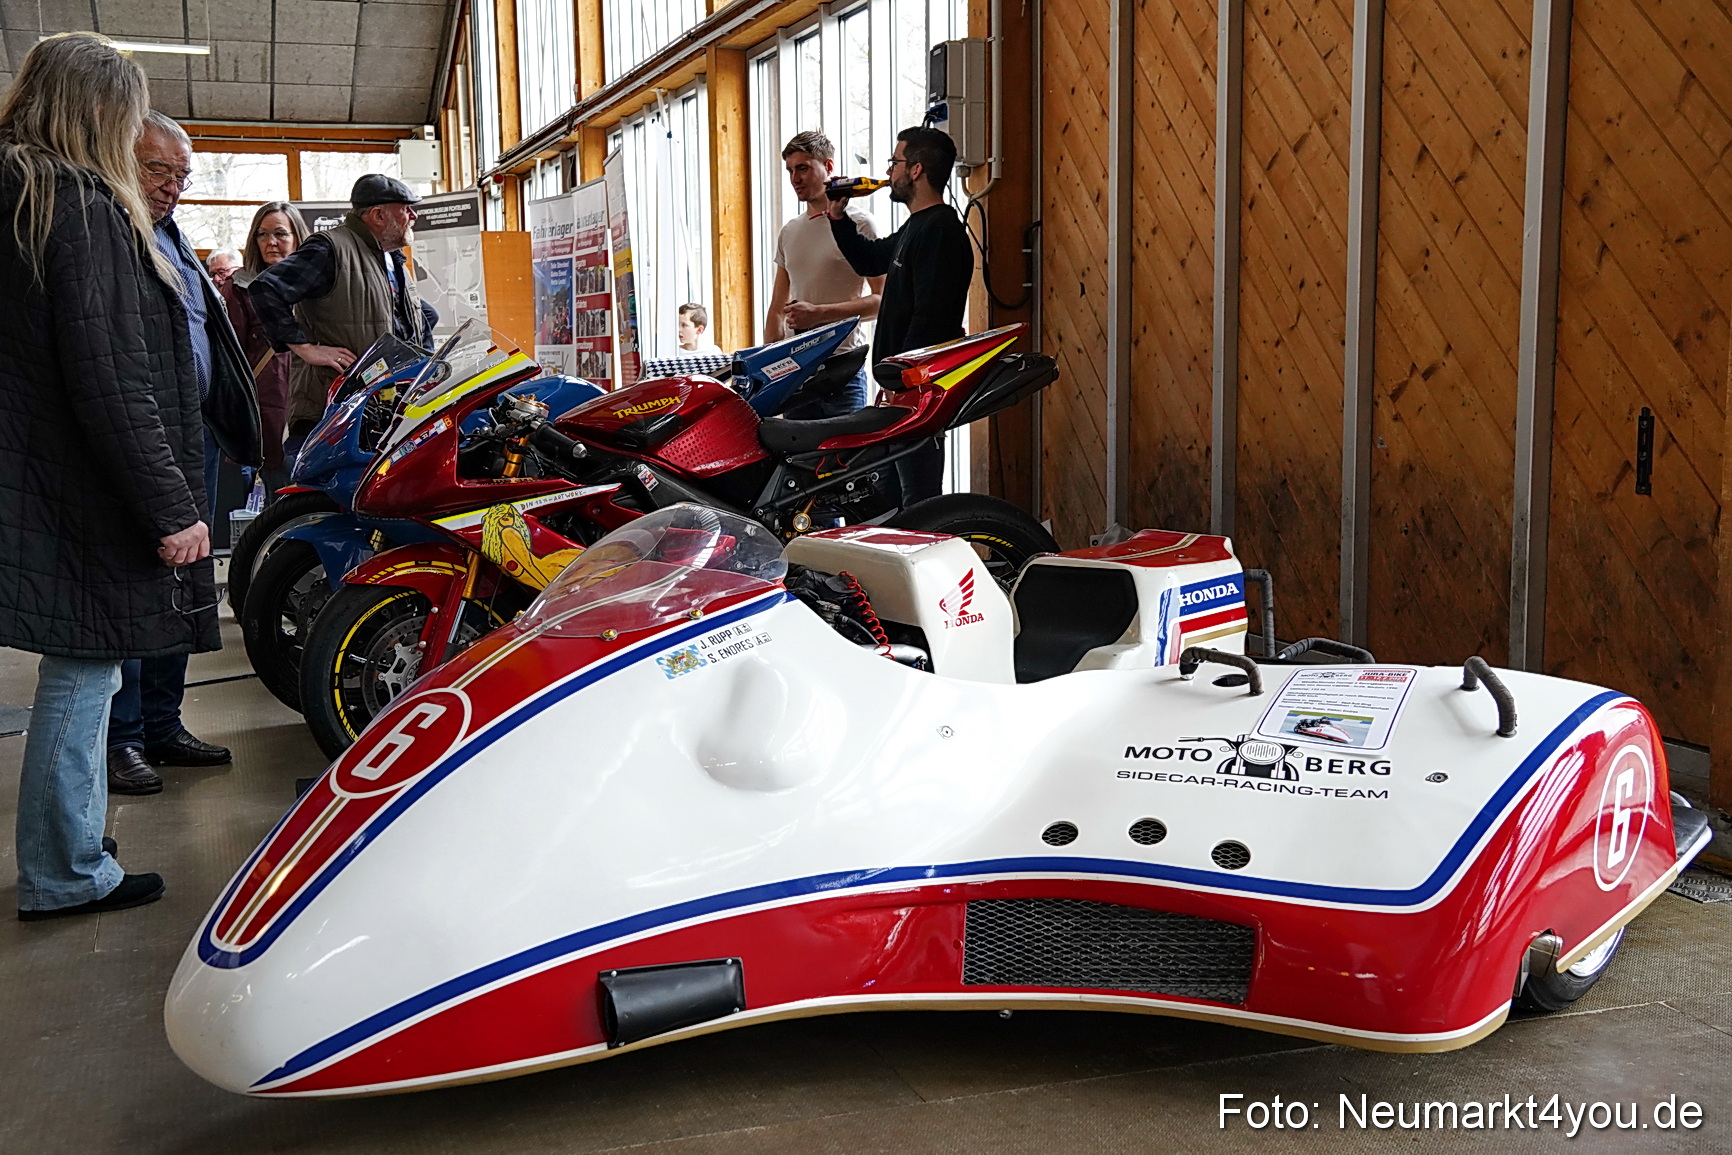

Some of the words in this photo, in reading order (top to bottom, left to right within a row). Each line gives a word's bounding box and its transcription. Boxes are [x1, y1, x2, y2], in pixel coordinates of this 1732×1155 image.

[613, 396, 681, 419] TRIUMPH
[1177, 582, 1240, 607] HONDA
[944, 612, 985, 629] HONDA
[708, 629, 733, 646] RUPP
[718, 638, 755, 660] ENDRES
[350, 702, 448, 782] 6
[1124, 745, 1213, 763] MOTO
[1305, 756, 1392, 776] BERG
[1116, 770, 1390, 800] SIDECAR-RACING-TEAM
[1607, 767, 1635, 869] 6
